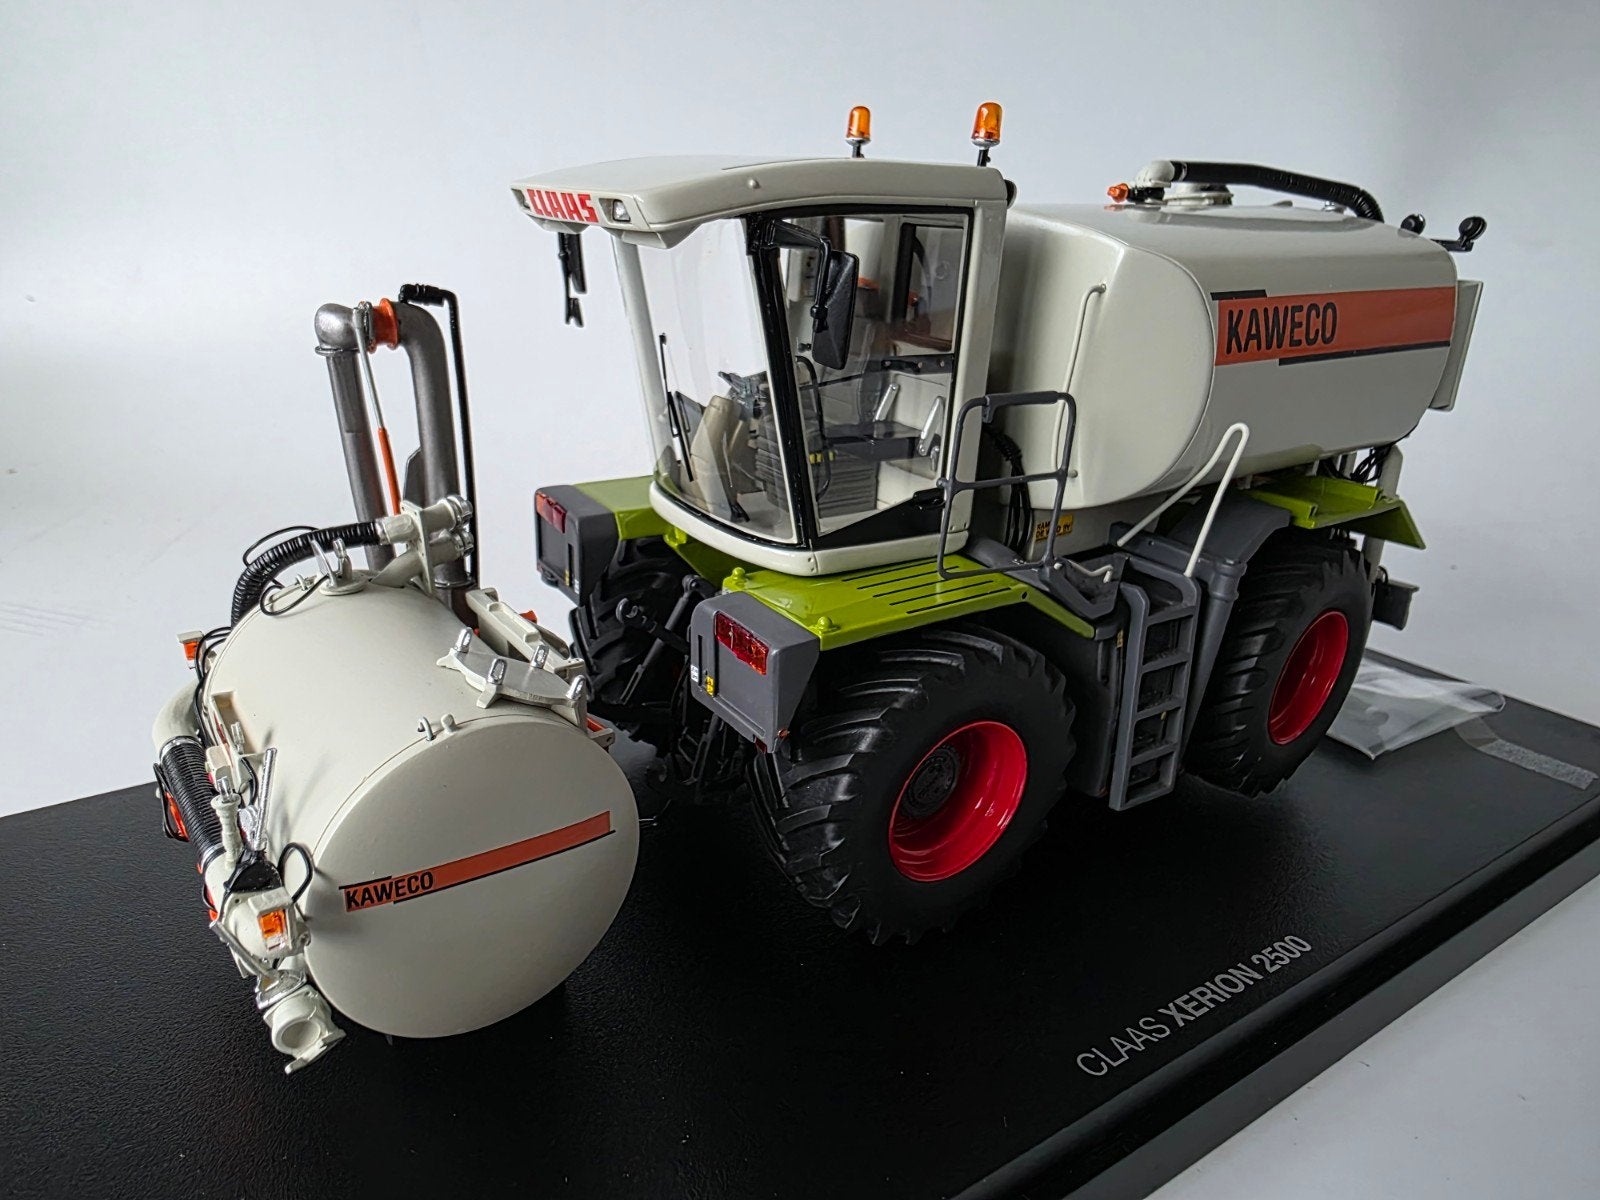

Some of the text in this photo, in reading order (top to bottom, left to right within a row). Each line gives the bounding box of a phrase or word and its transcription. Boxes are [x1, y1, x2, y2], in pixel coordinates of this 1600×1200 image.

[527, 188, 599, 223] CLAAS
[1226, 301, 1338, 355] KAWECO
[346, 871, 434, 910] KAWECO
[1077, 935, 1312, 1076] CLAAS XERION 2500
